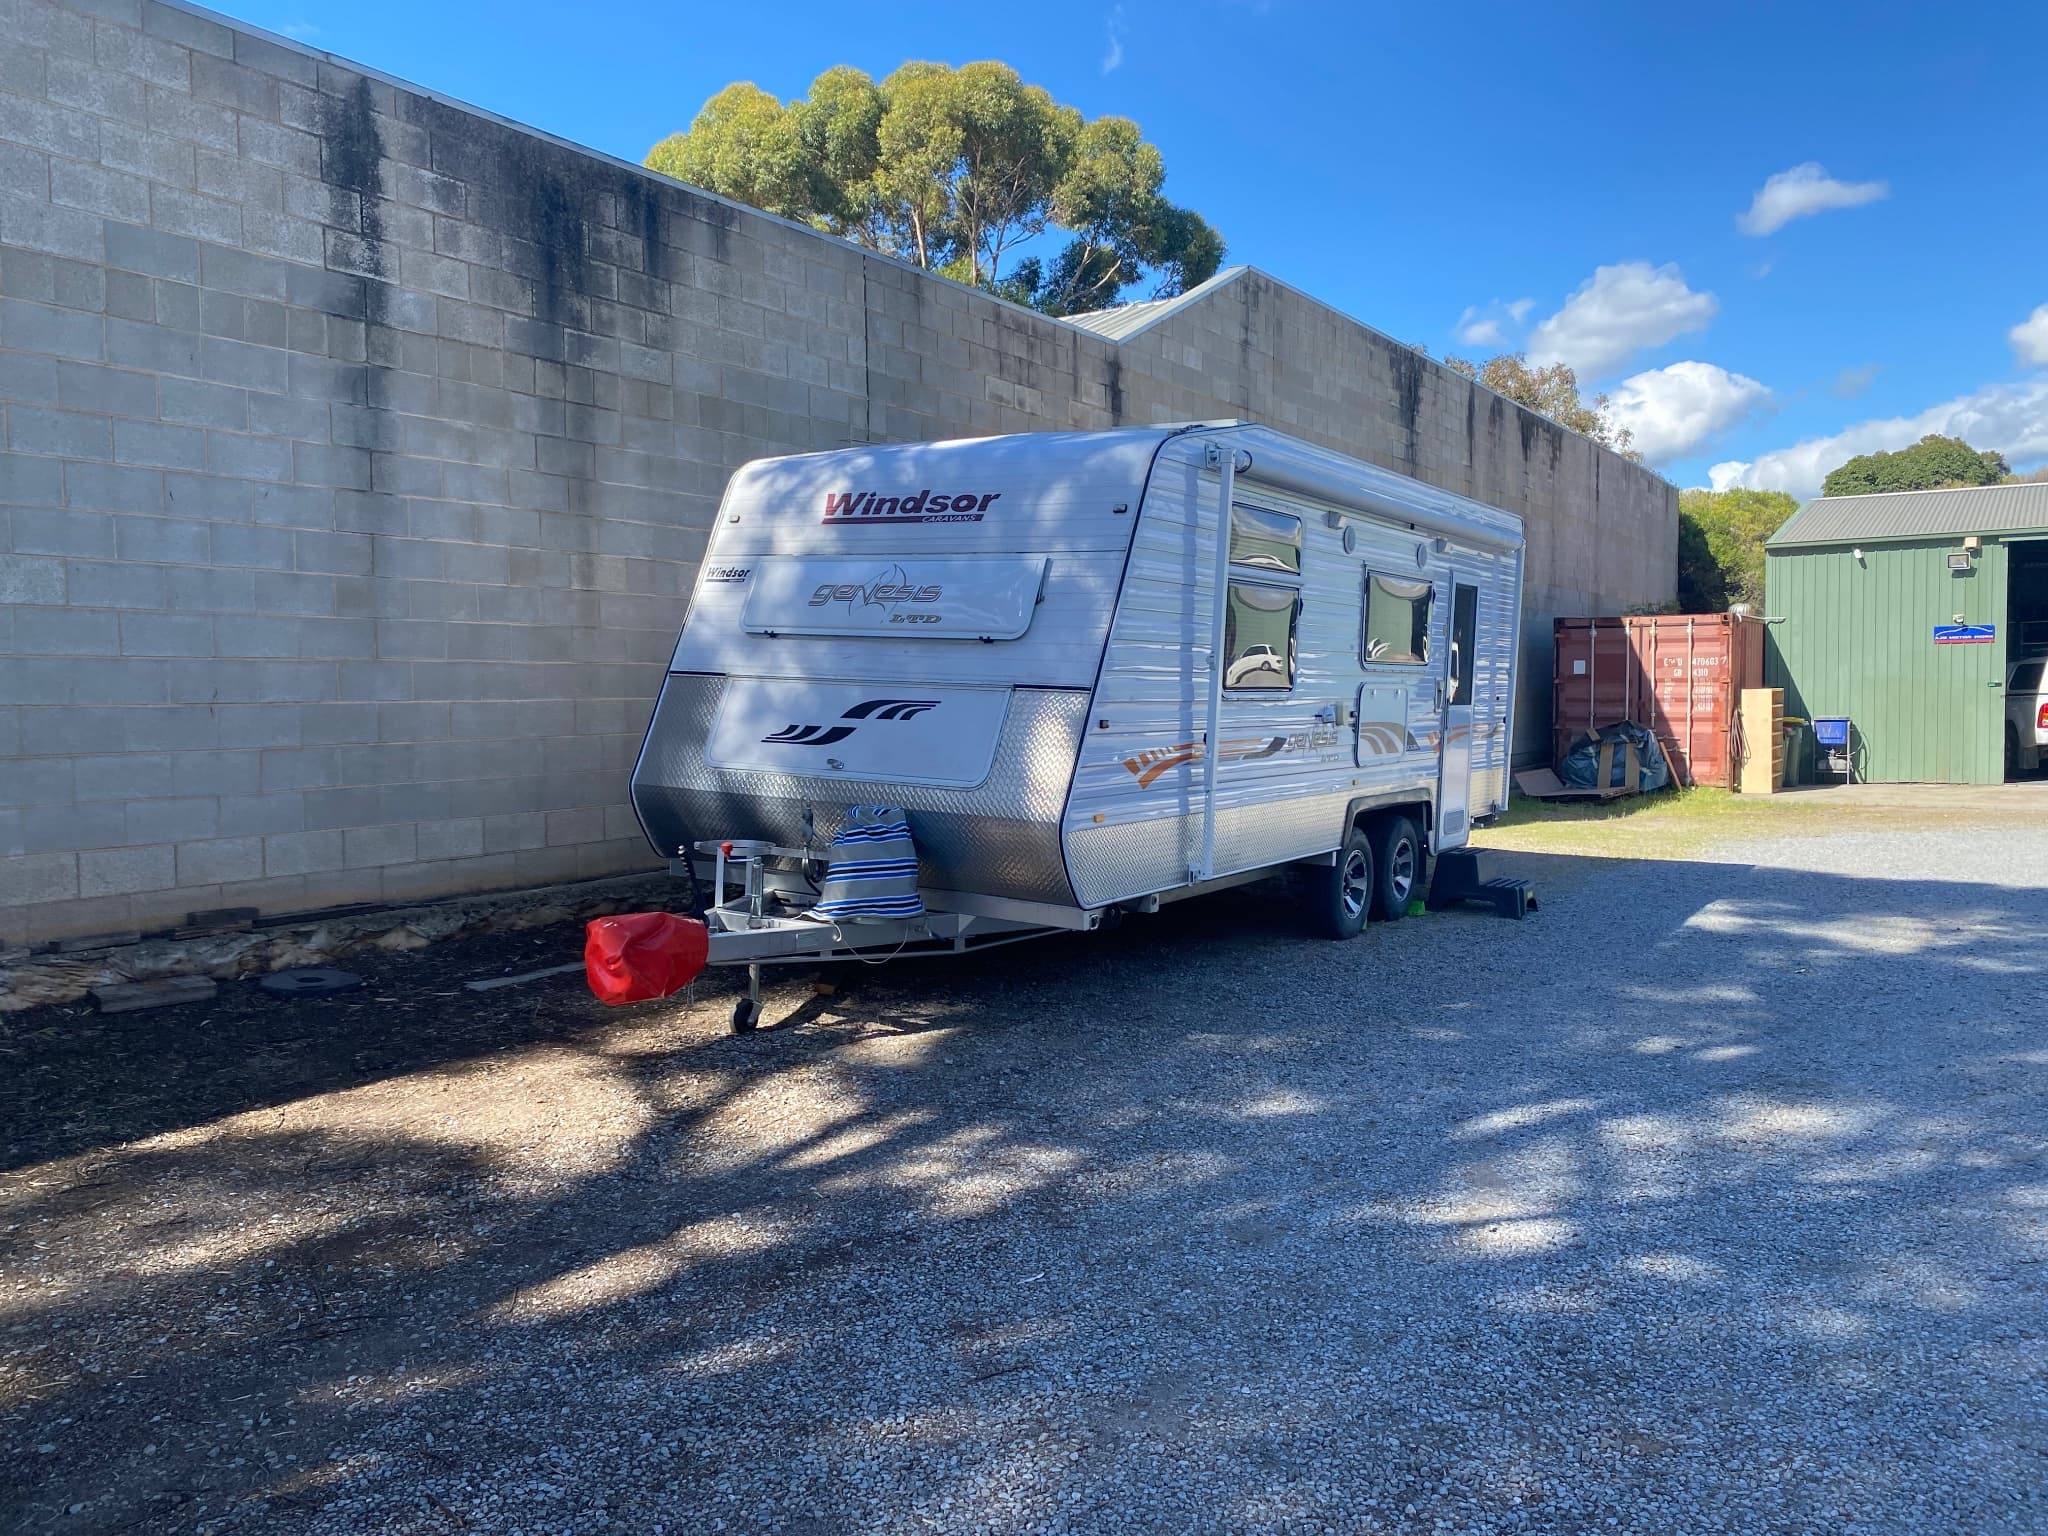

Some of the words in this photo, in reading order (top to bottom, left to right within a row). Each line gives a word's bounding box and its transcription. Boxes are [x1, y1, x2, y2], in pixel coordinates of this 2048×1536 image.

[825, 490, 1001, 516] Windsor
[921, 514, 976, 523] CARAVANS
[706, 567, 751, 578] Windsor
[889, 614, 942, 624] LTD
